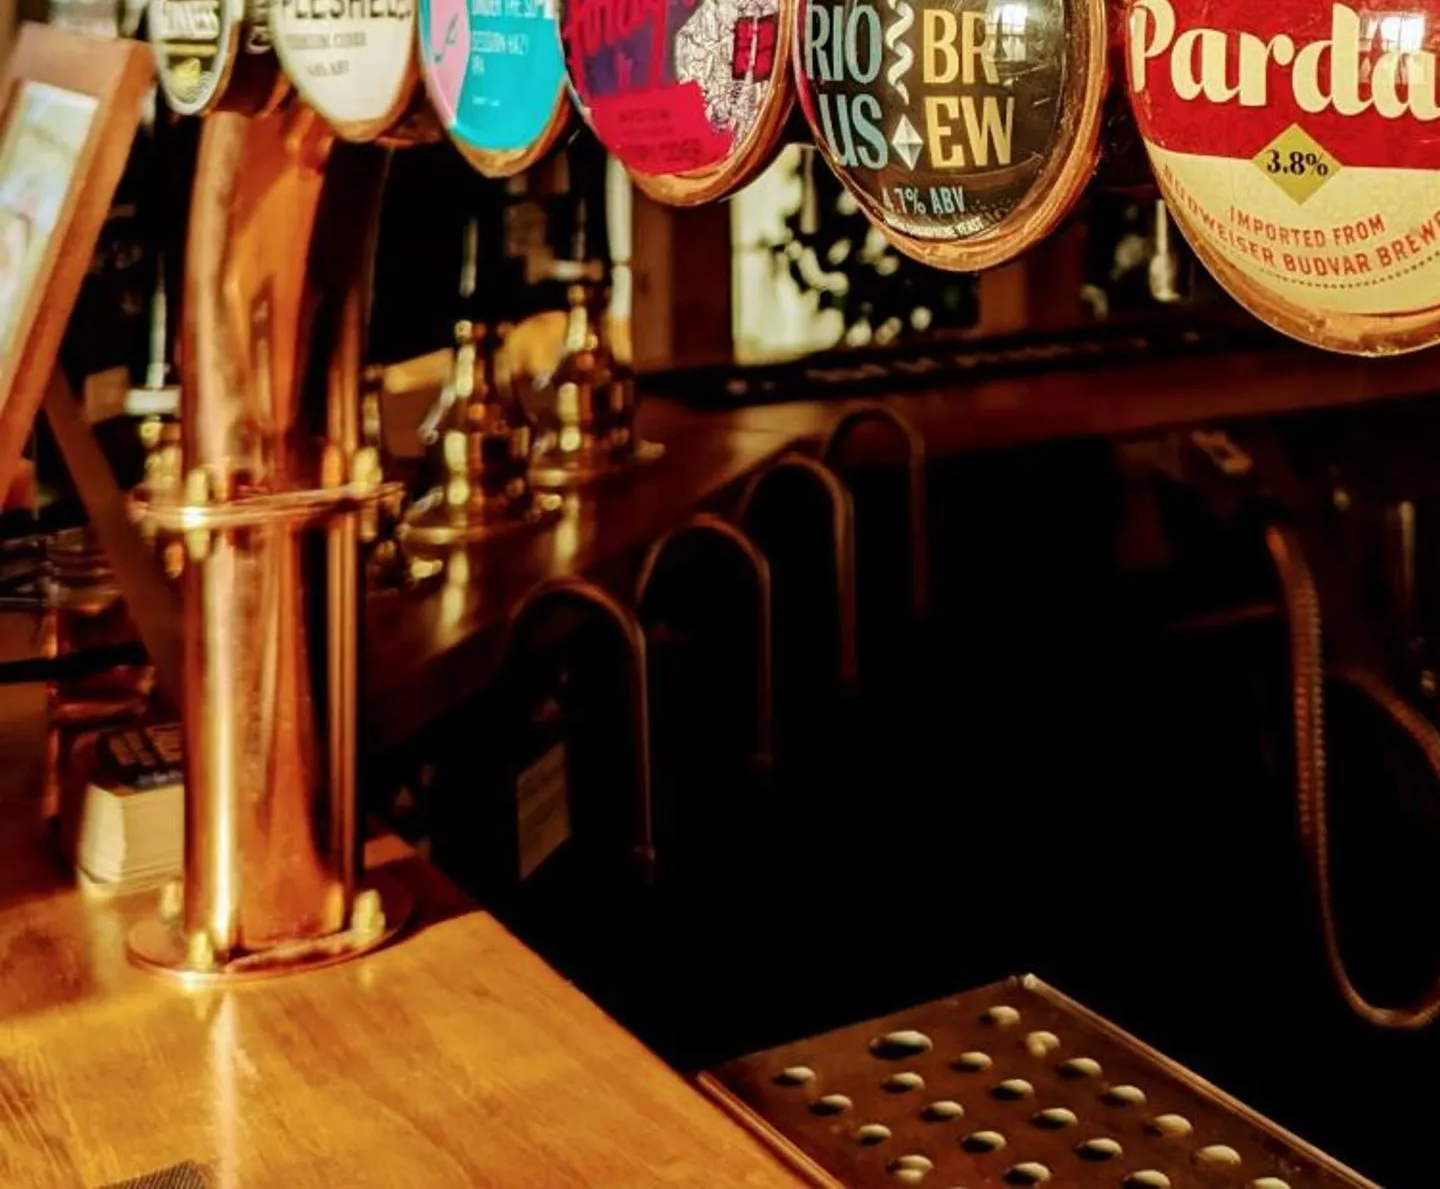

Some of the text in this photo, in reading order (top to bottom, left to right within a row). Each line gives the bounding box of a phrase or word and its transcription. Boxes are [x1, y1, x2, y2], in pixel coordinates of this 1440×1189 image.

[804, 1, 884, 84] RIO
[818, 92, 890, 171] US
[924, 95, 1015, 168] EW
[1266, 149, 1328, 178] 3.8%
[929, 185, 965, 215] ABV
[1229, 205, 1385, 248] IMPORTED FROM
[1283, 252, 1372, 278] BUDVAR
